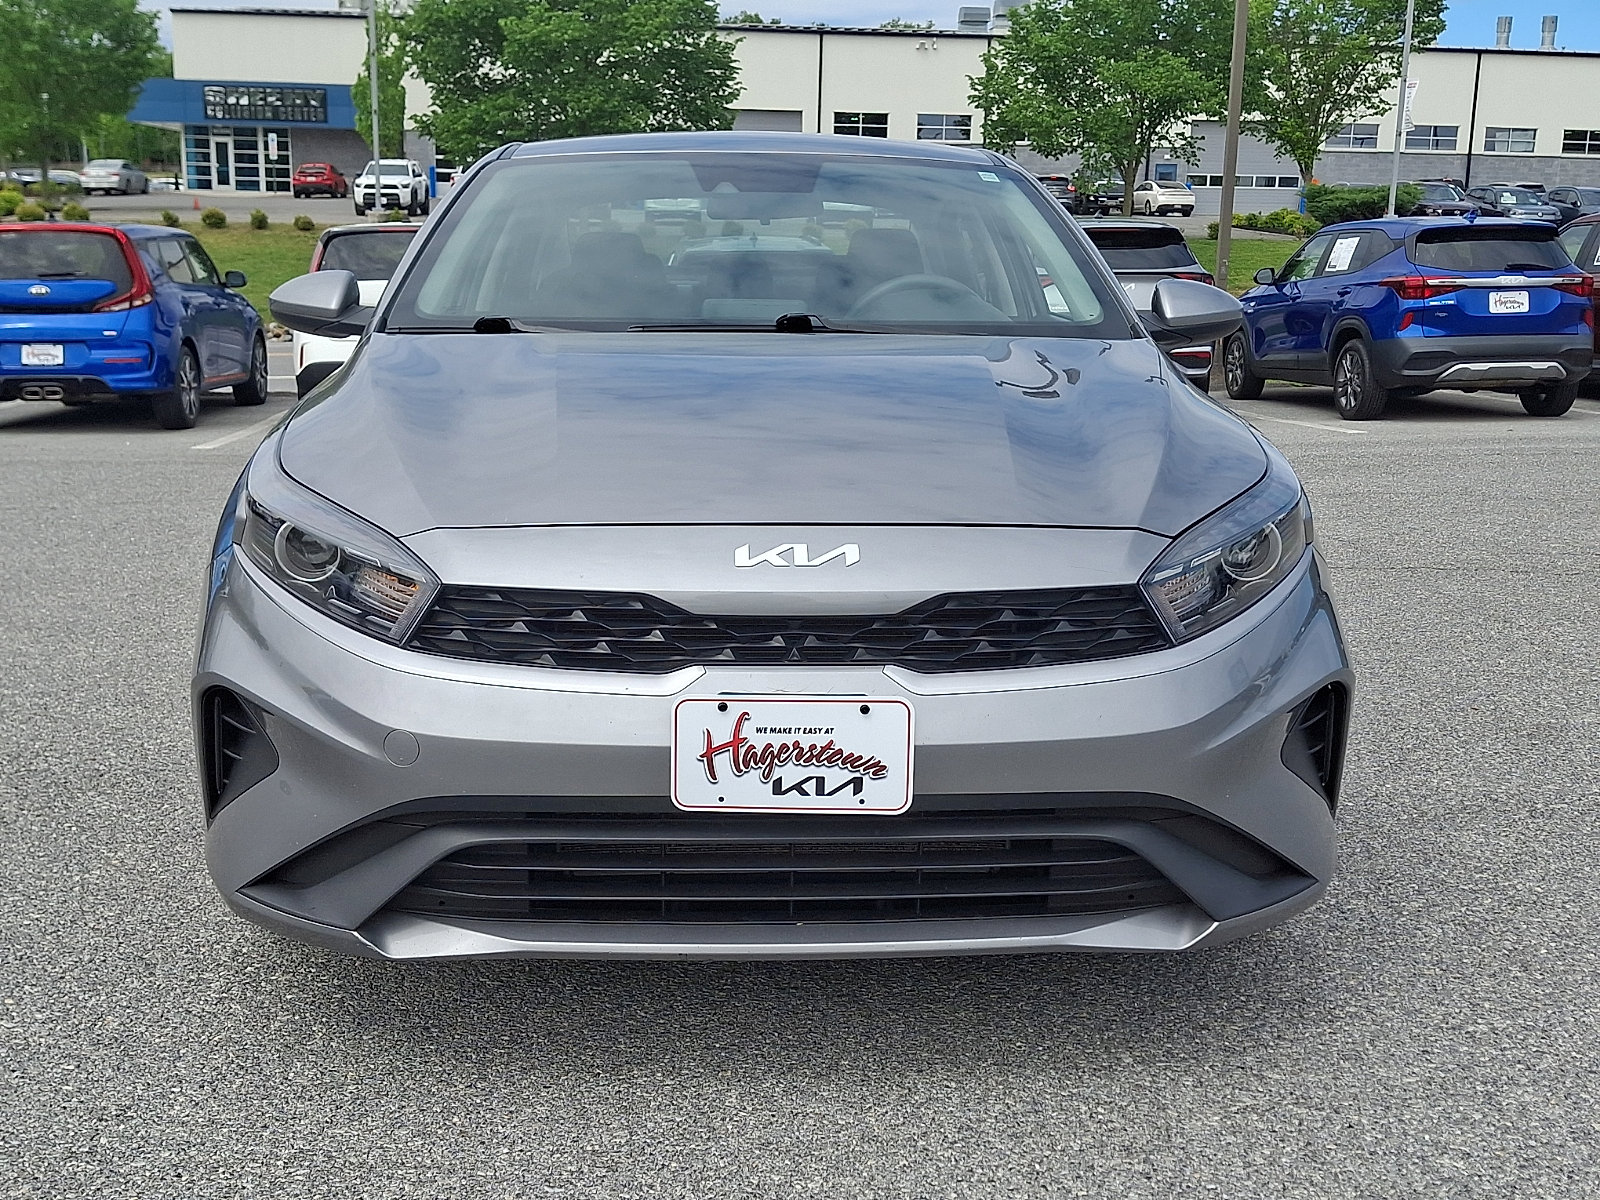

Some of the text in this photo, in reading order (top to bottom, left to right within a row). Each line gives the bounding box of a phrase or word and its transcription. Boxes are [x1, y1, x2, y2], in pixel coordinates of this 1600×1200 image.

[734, 543, 860, 567] KIA
[755, 726, 768, 734] WE
[793, 727, 802, 735] IT
[802, 727, 823, 735] EASY
[823, 727, 835, 735] AT
[698, 711, 888, 783] Hagerstown
[772, 776, 864, 796] KIA
